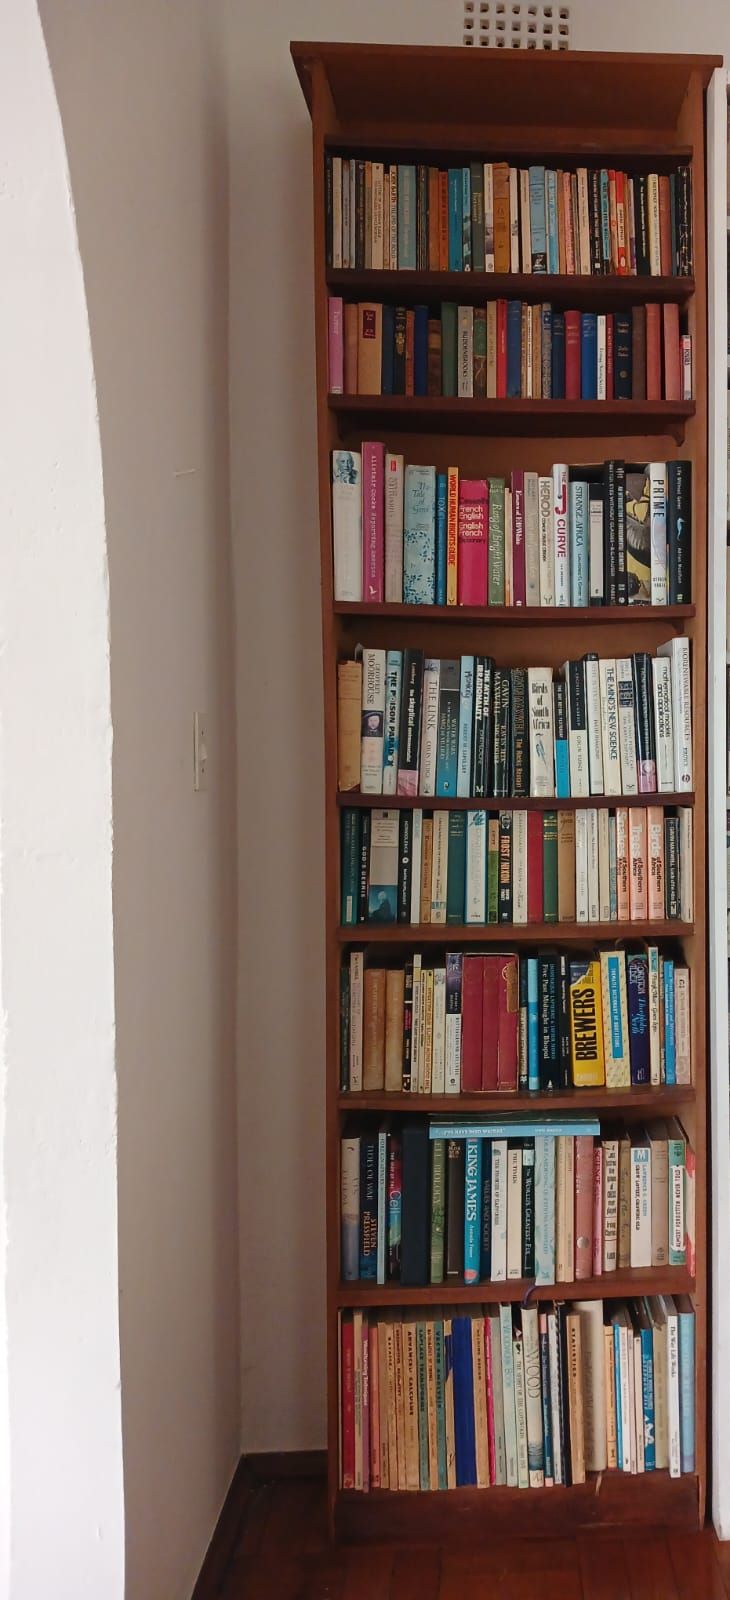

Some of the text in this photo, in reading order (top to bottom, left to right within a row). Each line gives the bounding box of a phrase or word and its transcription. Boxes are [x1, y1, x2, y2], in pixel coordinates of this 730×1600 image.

[541, 480, 551, 518] HEROD
[653, 480, 664, 518] PRIME
[576, 486, 584, 547] STRANGE AFRICA
[489, 535, 502, 558] Bright
[557, 518, 567, 558] CURVE
[492, 560, 502, 586] Water
[366, 654, 375, 705] MOORHOUSE
[390, 672, 398, 687] THE
[428, 680, 438, 700] THE
[476, 664, 484, 721] IRRATIONALITY
[501, 679, 509, 708] GAVIN
[531, 682, 548, 693] Birds
[662, 667, 671, 712] mathematical
[407, 697, 417, 727] skeptical
[426, 704, 437, 730] LINK
[483, 707, 489, 717] OF
[532, 706, 550, 717] South
[536, 694, 543, 706] of
[606, 668, 618, 760] THE MIND'S NEW SCIENCE
[655, 683, 664, 738] and applications
[532, 718, 550, 730] Africa
[631, 823, 643, 857] Trees
[650, 823, 662, 857] Birds
[501, 835, 511, 883] FROST NIXON
[541, 994, 550, 1024] Midnight
[572, 989, 598, 1060] BREWERS
[541, 1035, 550, 1059] Bhopal
[433, 1164, 442, 1204] BIOLOGY
[465, 1144, 478, 1221] KING JAMES
[594, 1149, 602, 1185] SCIENCE
[366, 1182, 375, 1200] WAR
[389, 1190, 402, 1214] Cell
[363, 1211, 371, 1256] PRESSFIELD
[674, 1229, 682, 1248] ALMOST
[526, 1348, 541, 1399] WOOD
